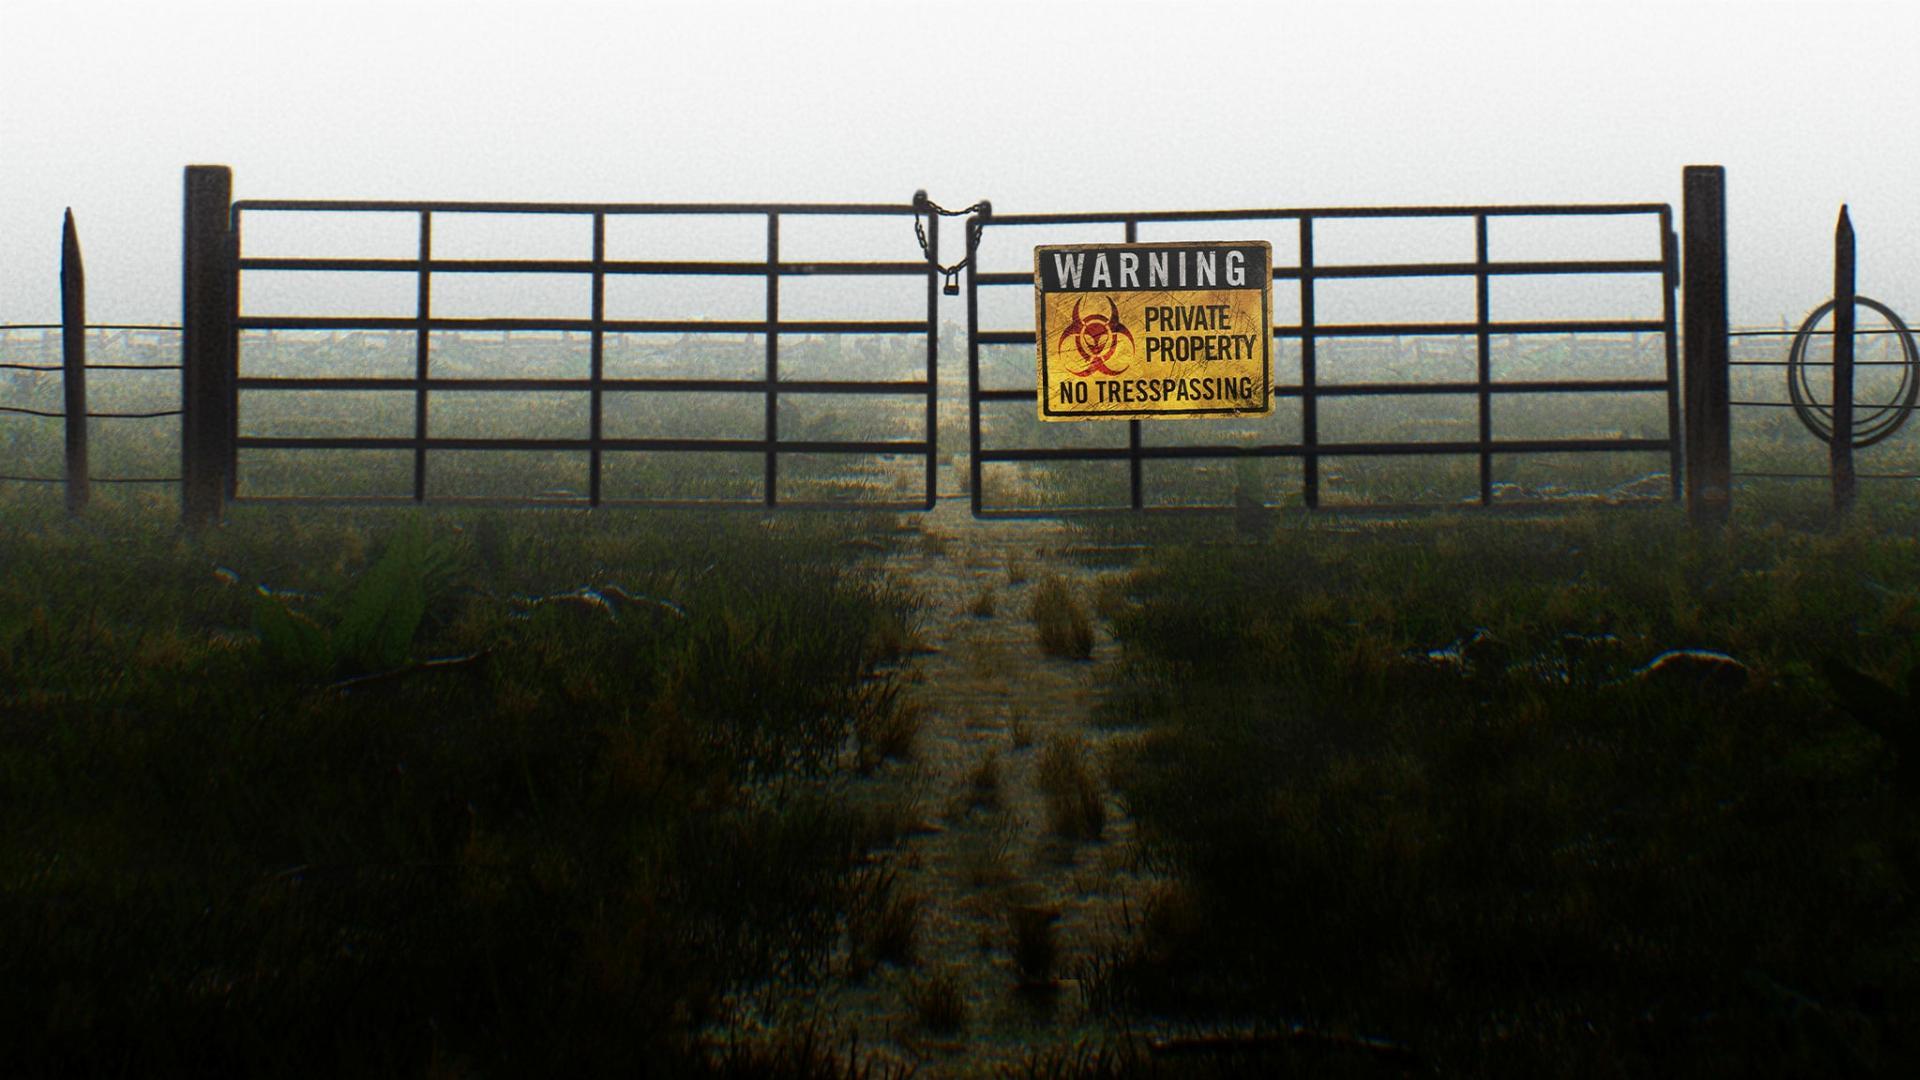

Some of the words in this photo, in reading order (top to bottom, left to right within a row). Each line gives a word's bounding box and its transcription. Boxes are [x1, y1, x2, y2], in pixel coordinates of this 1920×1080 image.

[1054, 250, 1245, 289] WARNING
[1145, 304, 1231, 332] PRIVATE
[1145, 334, 1256, 362] PROPERTY
[1060, 380, 1088, 404] NO
[1096, 377, 1252, 403] TRESSPASSING
